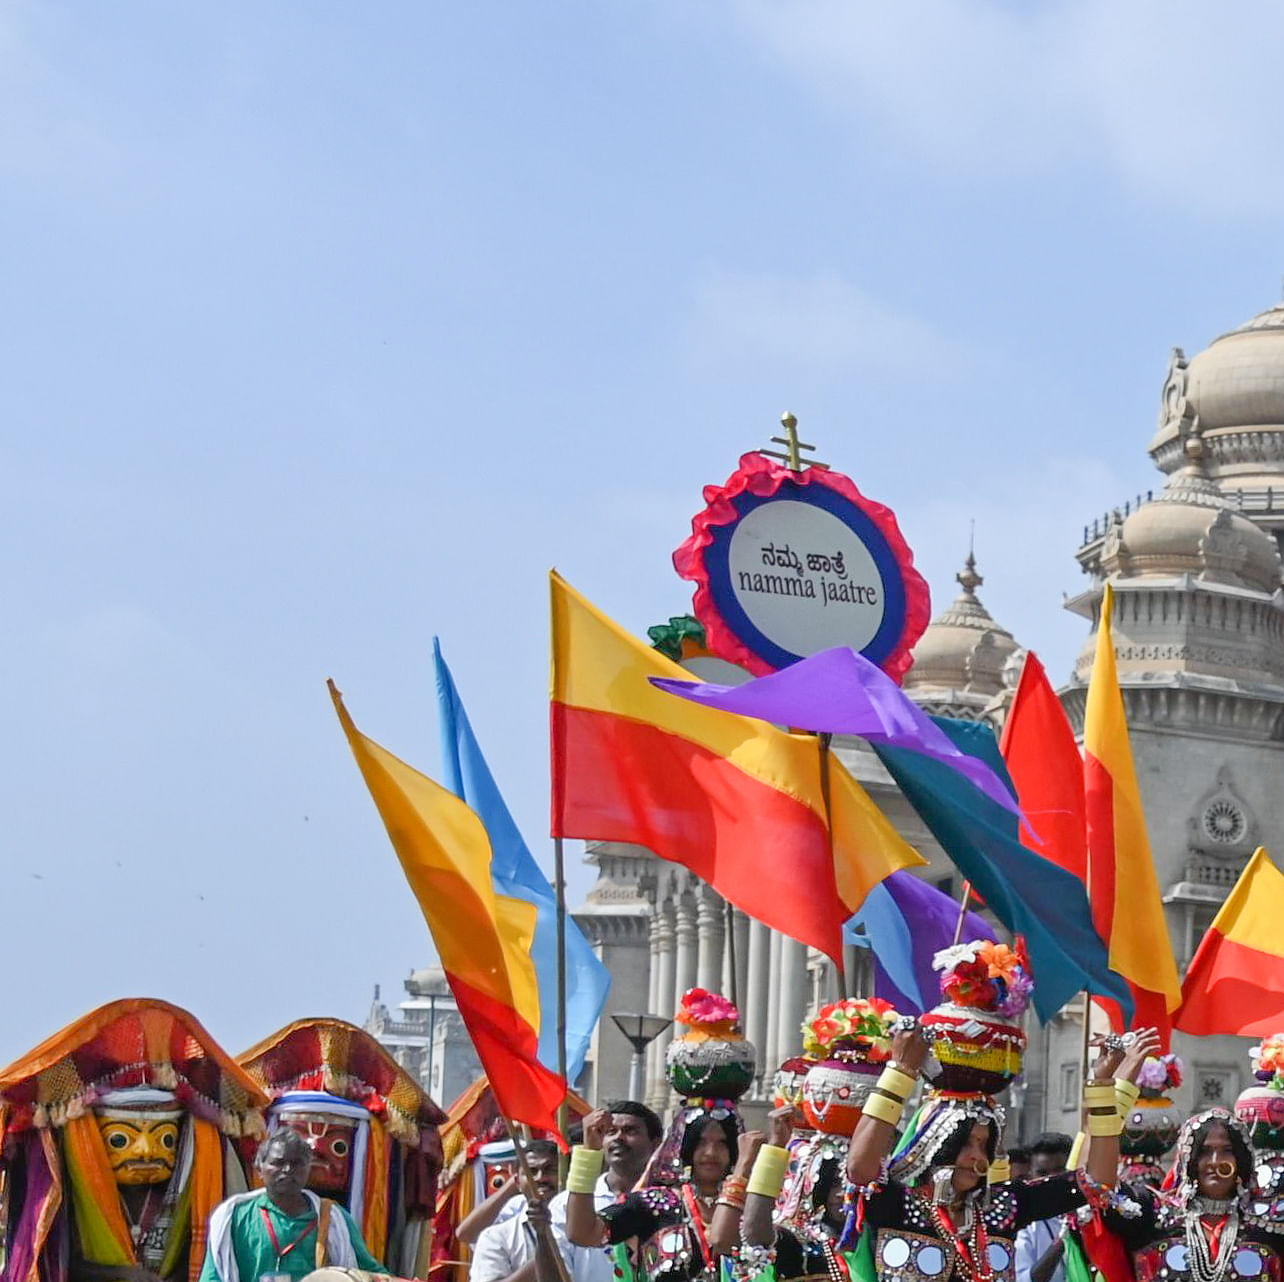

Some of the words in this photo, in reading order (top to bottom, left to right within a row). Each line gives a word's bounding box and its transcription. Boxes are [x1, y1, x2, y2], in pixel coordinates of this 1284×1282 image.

[761, 542, 804, 577] ನಮ್ಮ
[806, 551, 848, 580] ಜಾತ್ರೆ
[738, 571, 816, 599] namma
[820, 576, 877, 607] jaatre
